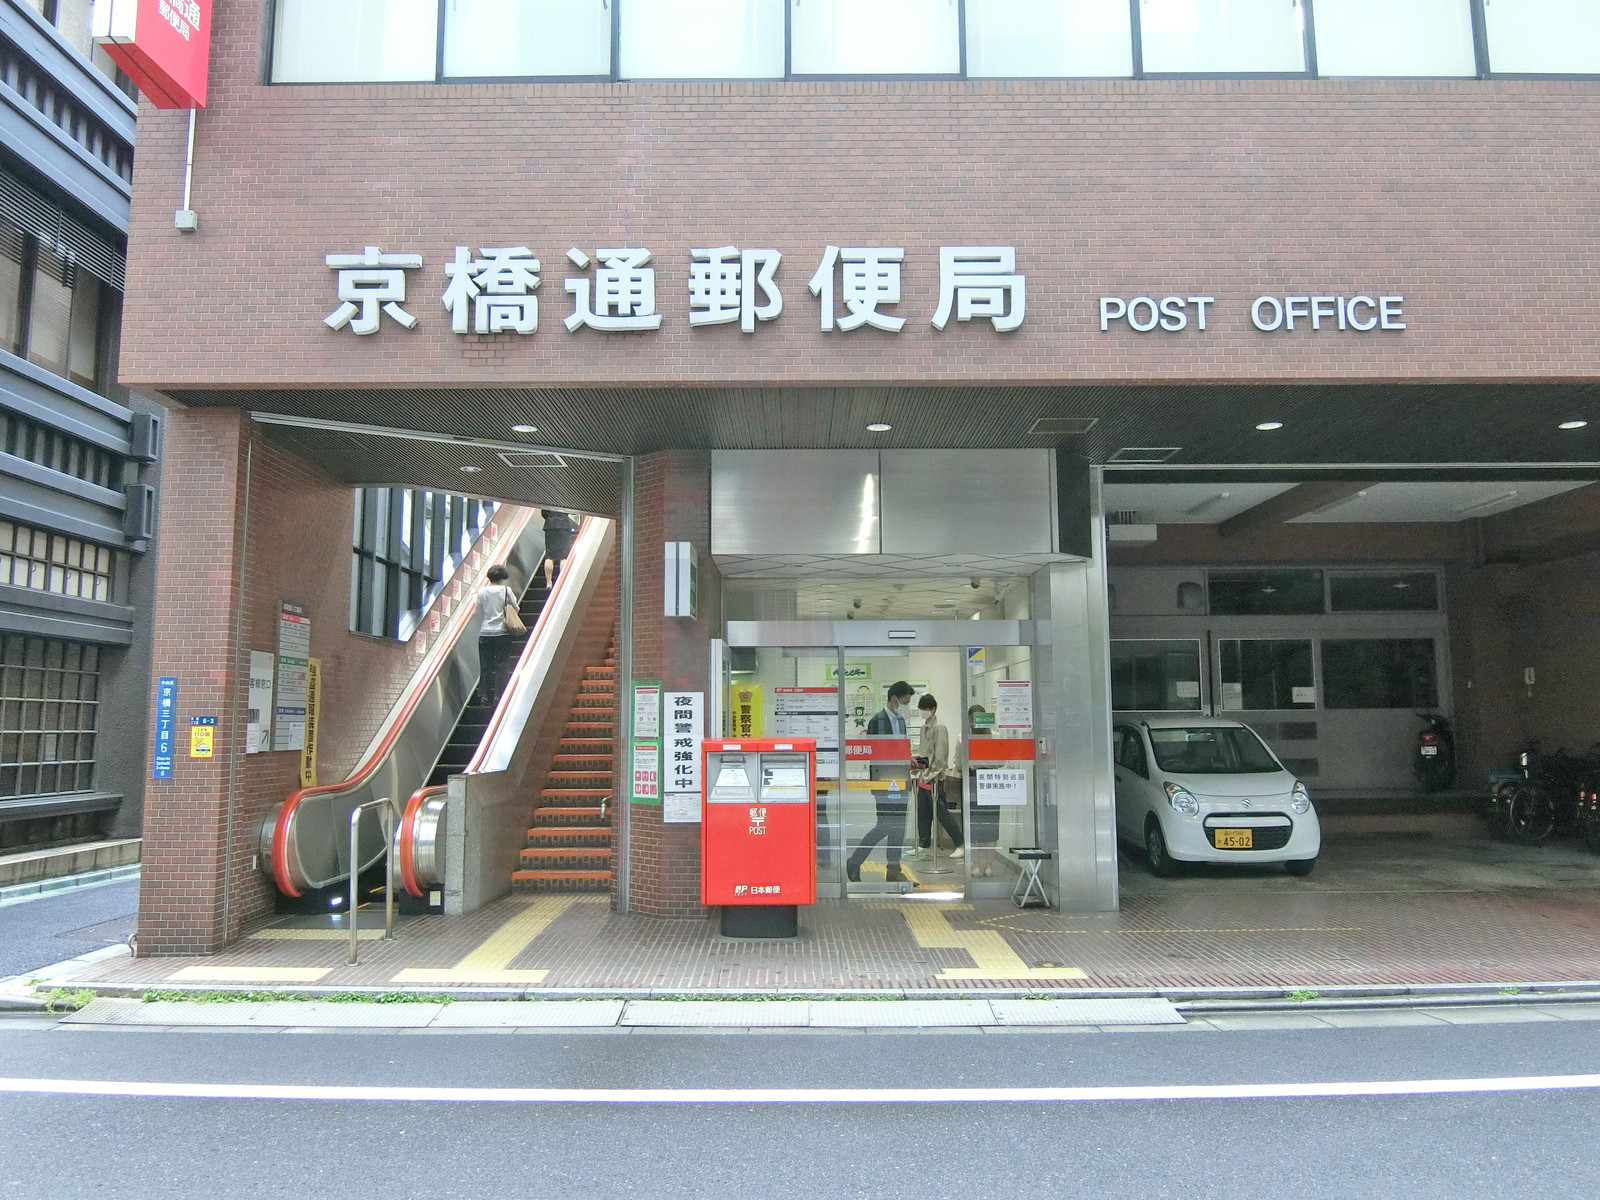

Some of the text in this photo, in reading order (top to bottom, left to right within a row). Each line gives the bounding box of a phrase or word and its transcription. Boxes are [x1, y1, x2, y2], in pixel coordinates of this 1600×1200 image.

[323, 245, 1027, 337] 京橋通郵便局
[1099, 294, 1408, 333] POST OFFICE
[202, 717, 215, 725] 6-3
[674, 696, 693, 789] 夜間警戒強化中
[749, 807, 767, 818] 郵便
[749, 826, 767, 835] POST
[1224, 837, 1250, 847] 45-02
[750, 886, 781, 895] 日本郵便
